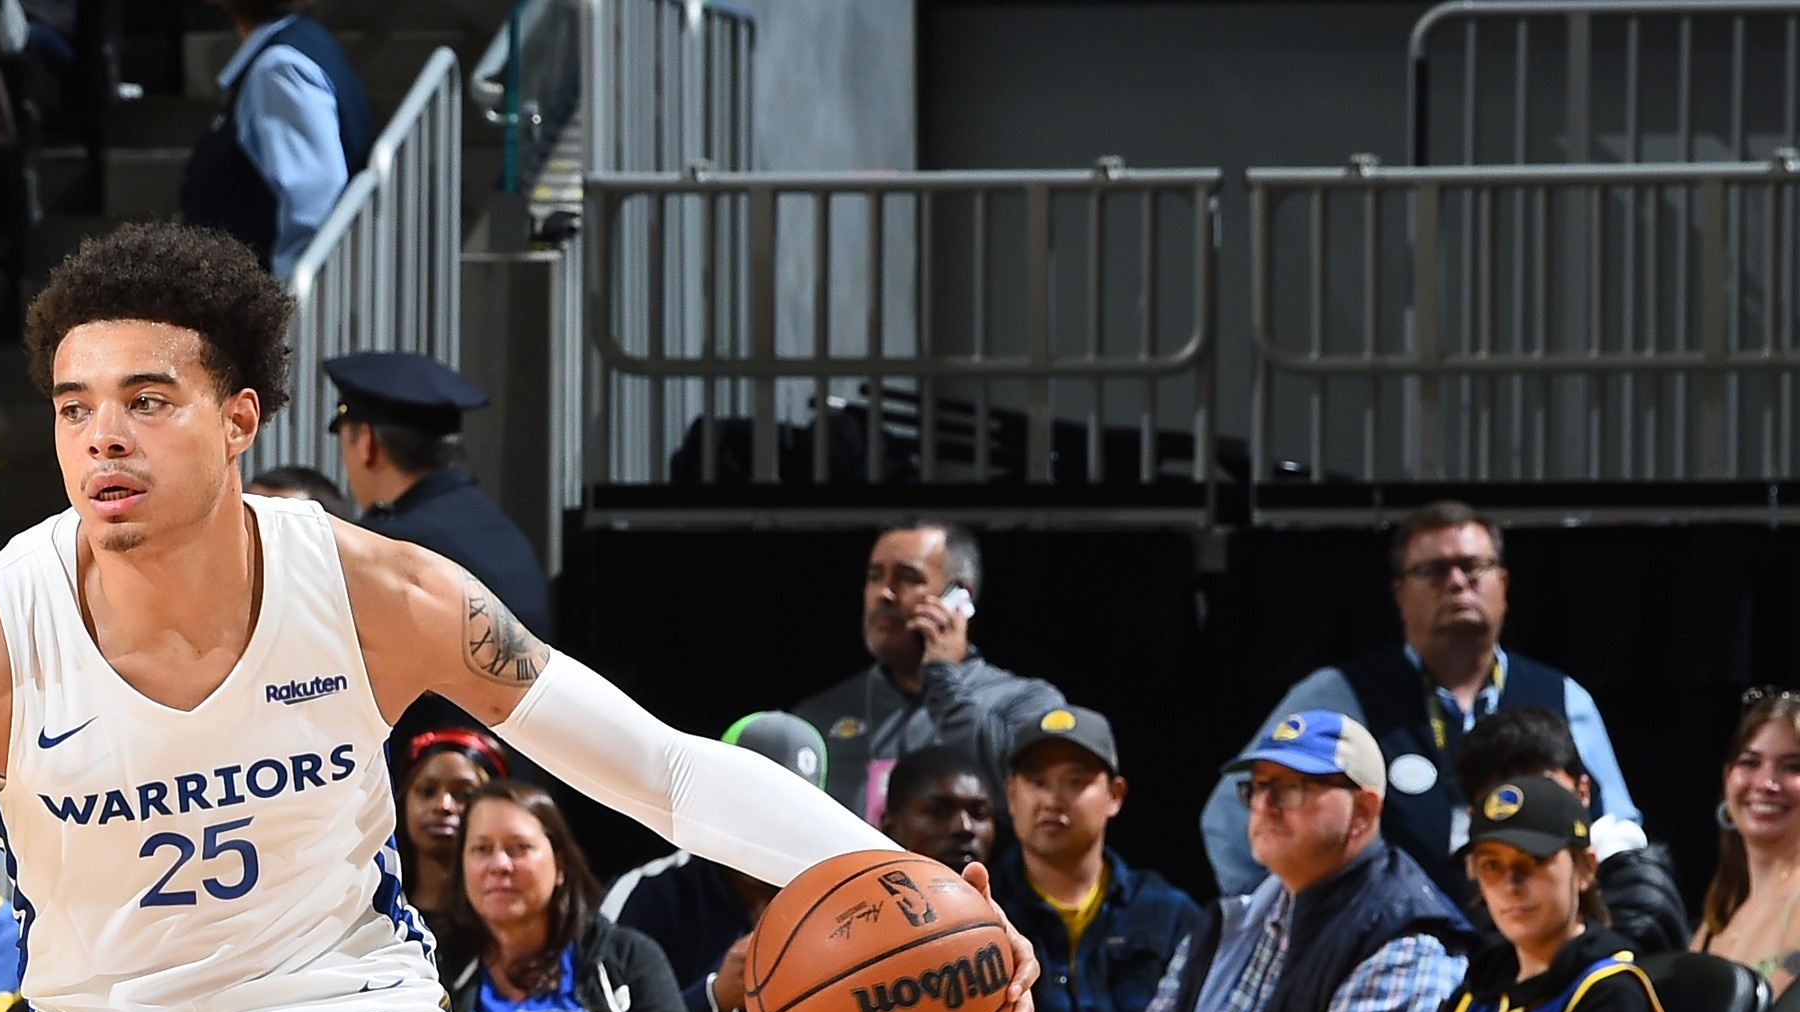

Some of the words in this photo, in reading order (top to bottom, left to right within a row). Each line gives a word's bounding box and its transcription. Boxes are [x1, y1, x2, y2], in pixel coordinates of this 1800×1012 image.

[265, 675, 348, 705] Rakuten
[37, 744, 356, 825] WARRIORS
[138, 816, 260, 909] 25
